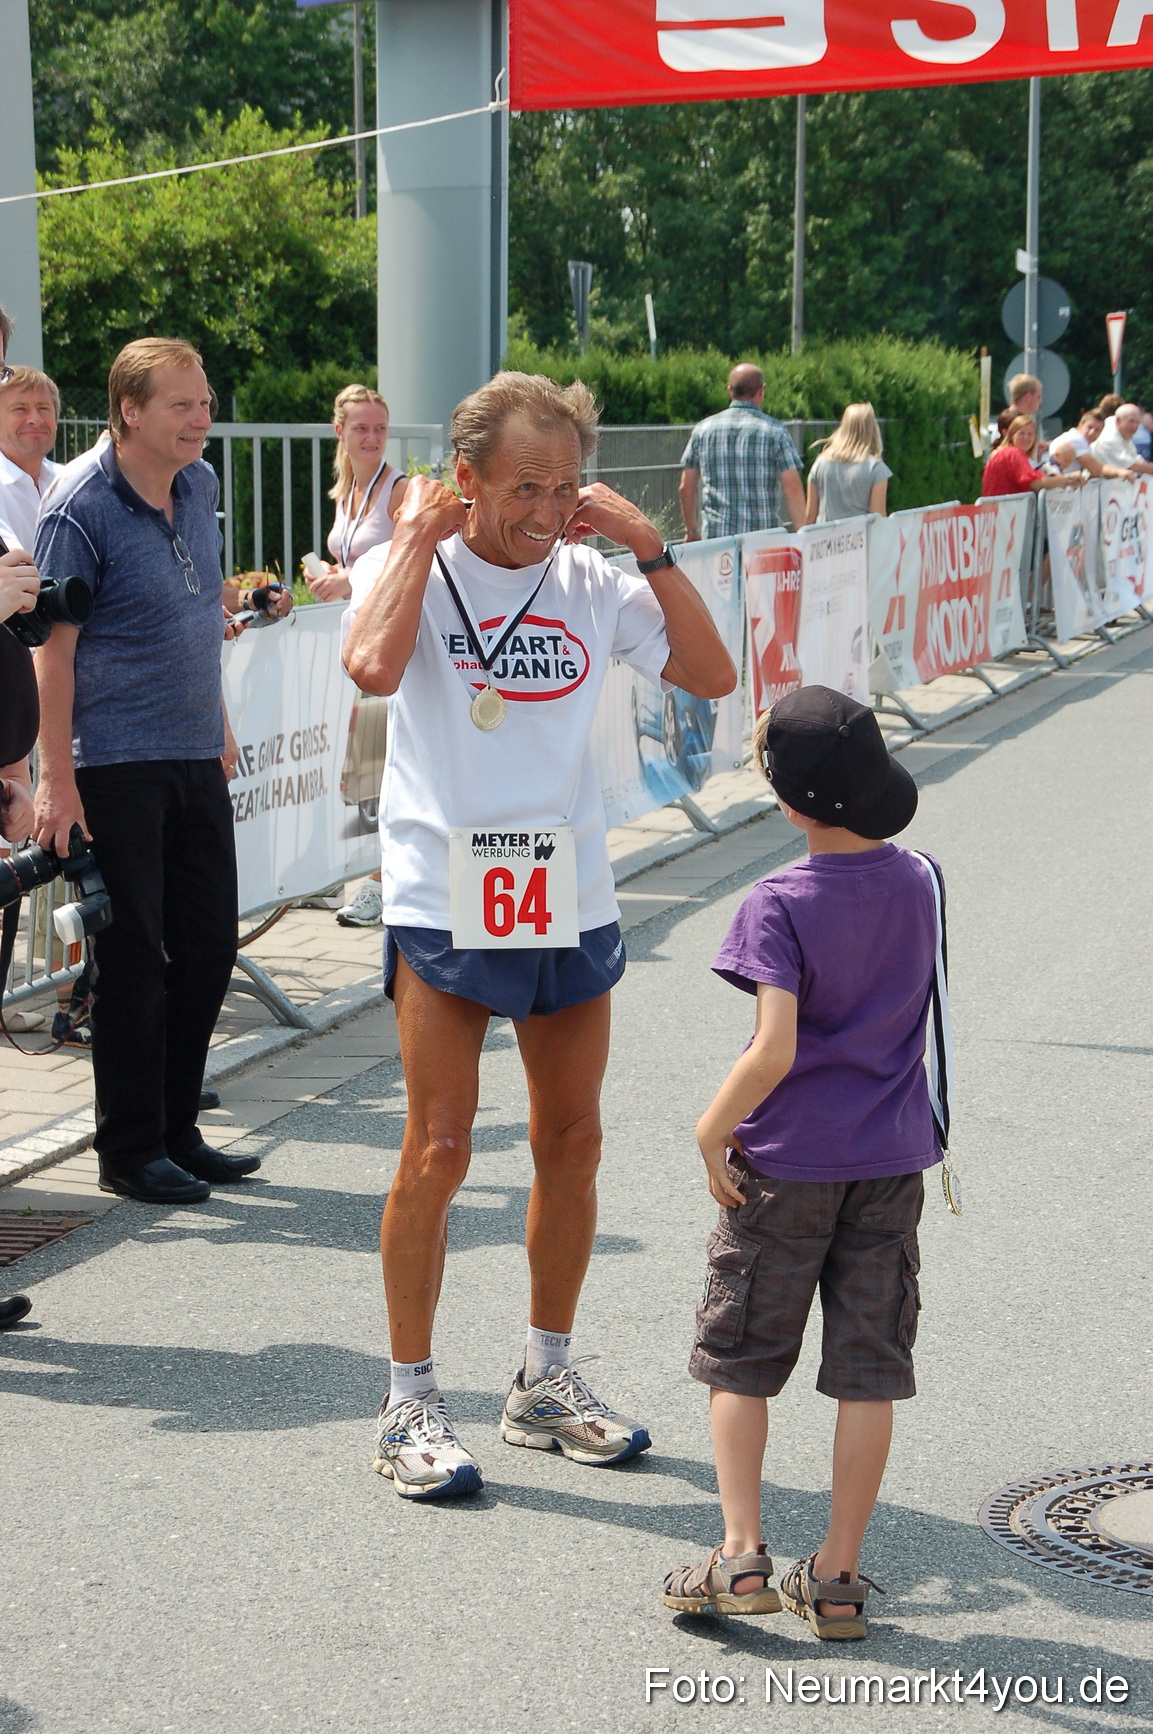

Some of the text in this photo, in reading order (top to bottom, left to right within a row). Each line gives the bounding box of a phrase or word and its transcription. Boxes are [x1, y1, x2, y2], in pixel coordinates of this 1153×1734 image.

[562, 645, 571, 656] &
[231, 744, 255, 780] IE
[289, 722, 331, 762] GROSS.
[472, 833, 530, 847] MEYER
[472, 848, 530, 858] WERBUNG
[483, 867, 552, 937] 64
[540, 1334, 561, 1348] TECH
[393, 1366, 410, 1378] TECH
